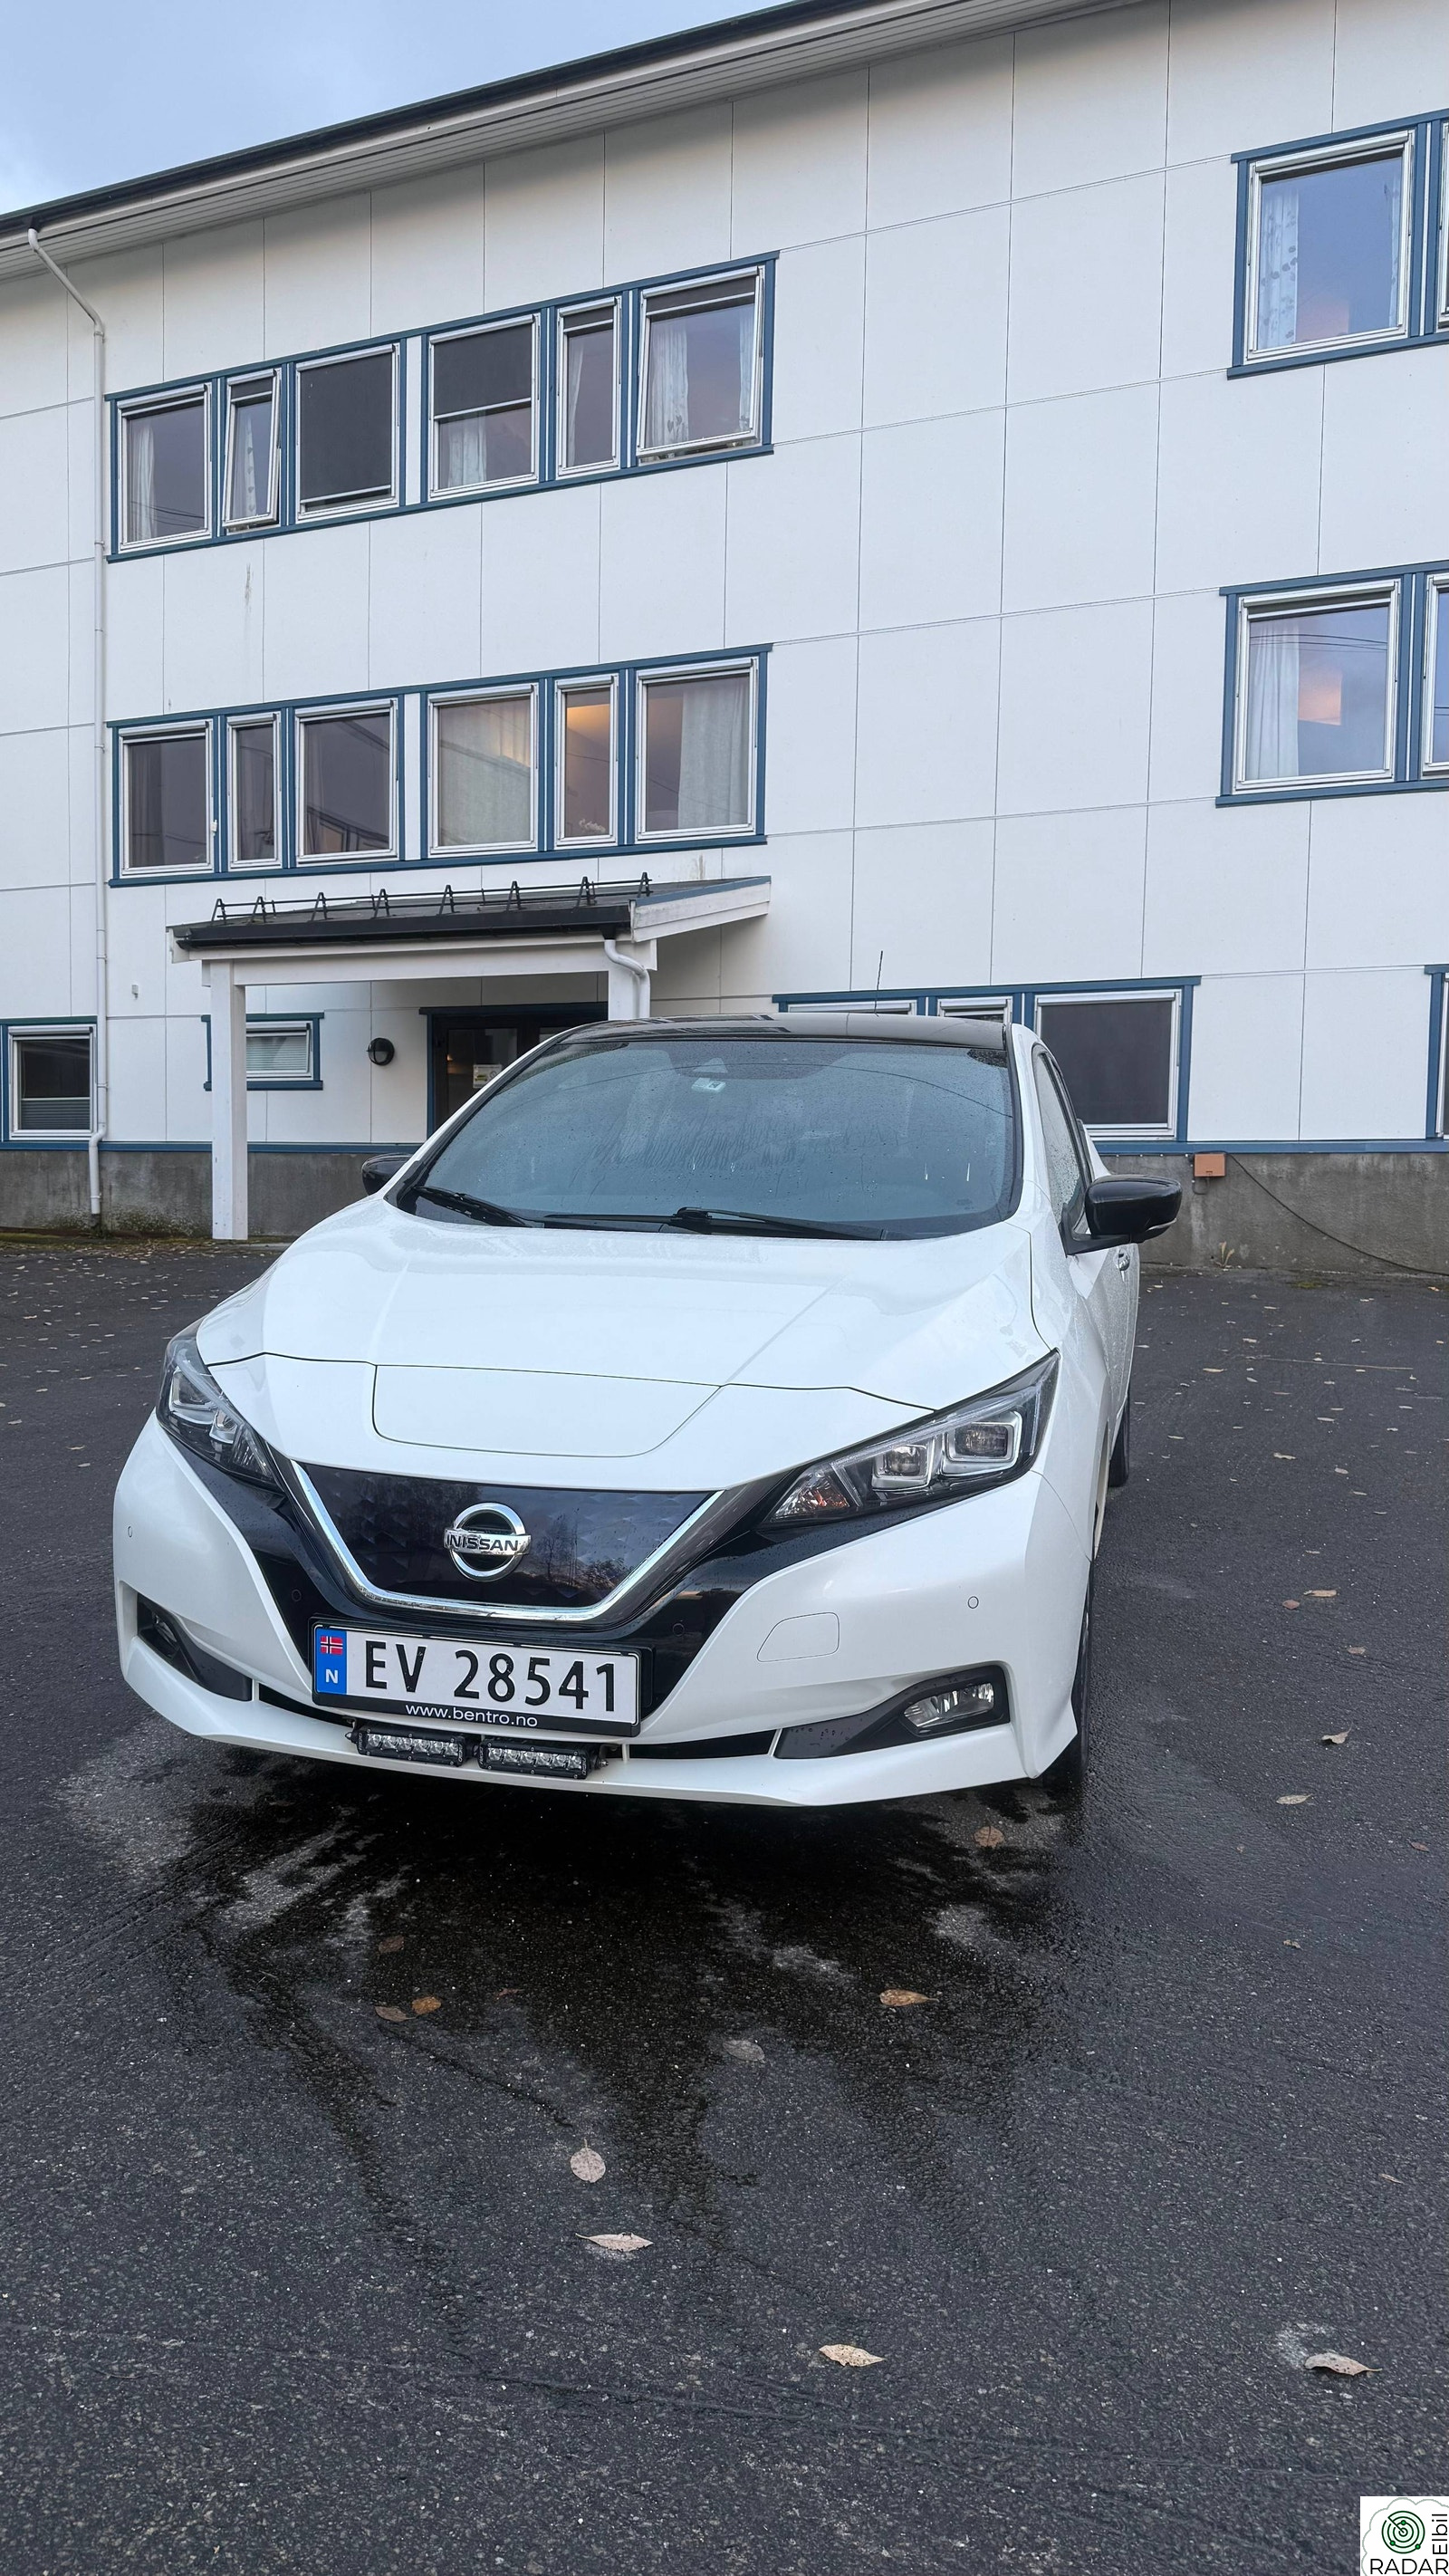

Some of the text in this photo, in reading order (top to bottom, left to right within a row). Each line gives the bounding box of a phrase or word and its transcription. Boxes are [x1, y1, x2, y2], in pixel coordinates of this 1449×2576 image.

[446, 1534, 519, 1552] NISSAN
[325, 1668, 339, 1685] N
[365, 1640, 615, 1712] EV 28541
[405, 1704, 538, 1727] www.bentro.no
